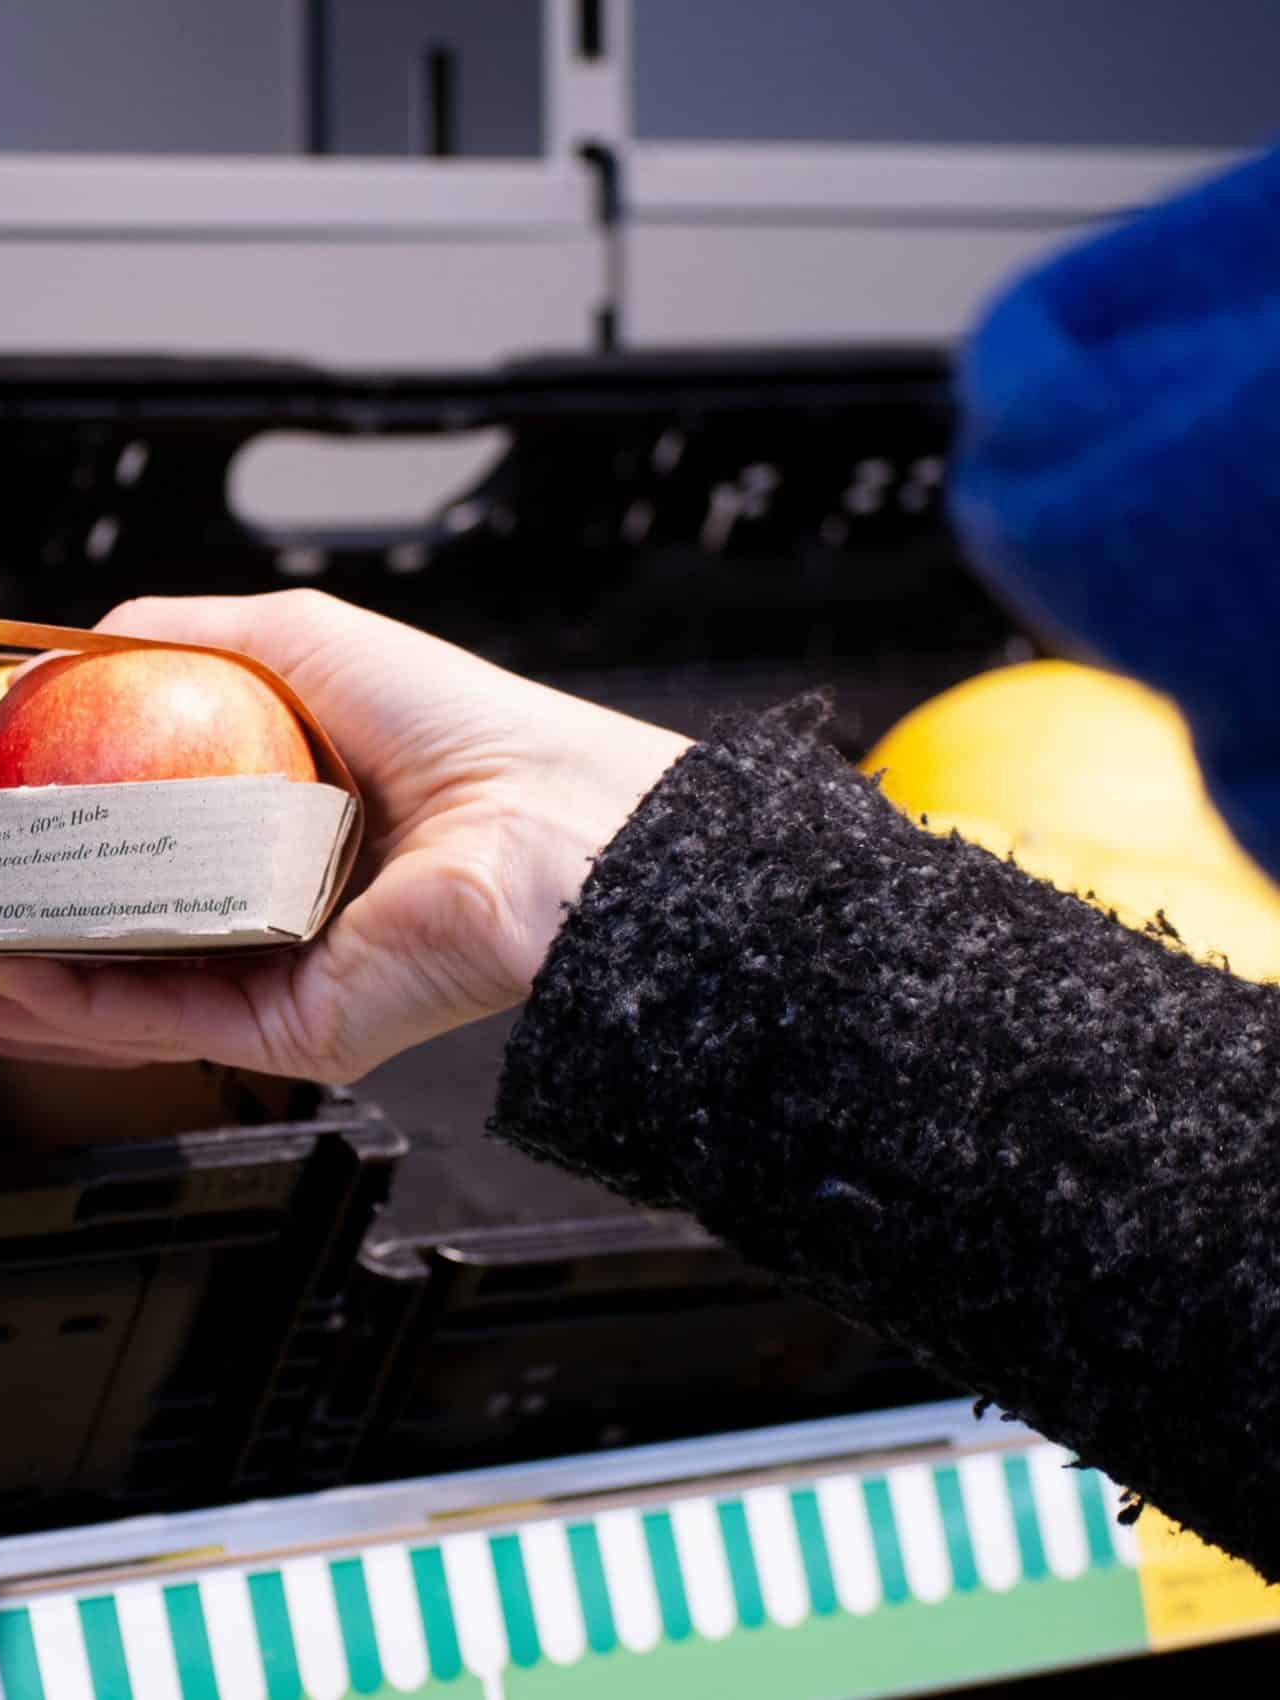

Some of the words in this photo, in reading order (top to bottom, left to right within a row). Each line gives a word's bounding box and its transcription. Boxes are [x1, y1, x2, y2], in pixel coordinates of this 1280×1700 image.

[30, 814, 66, 834] 60%
[71, 804, 109, 826] Holz
[96, 835, 177, 858] Rohstoffe
[40, 899, 169, 919] nachwachsenden
[172, 895, 248, 916] Rohstoffen
